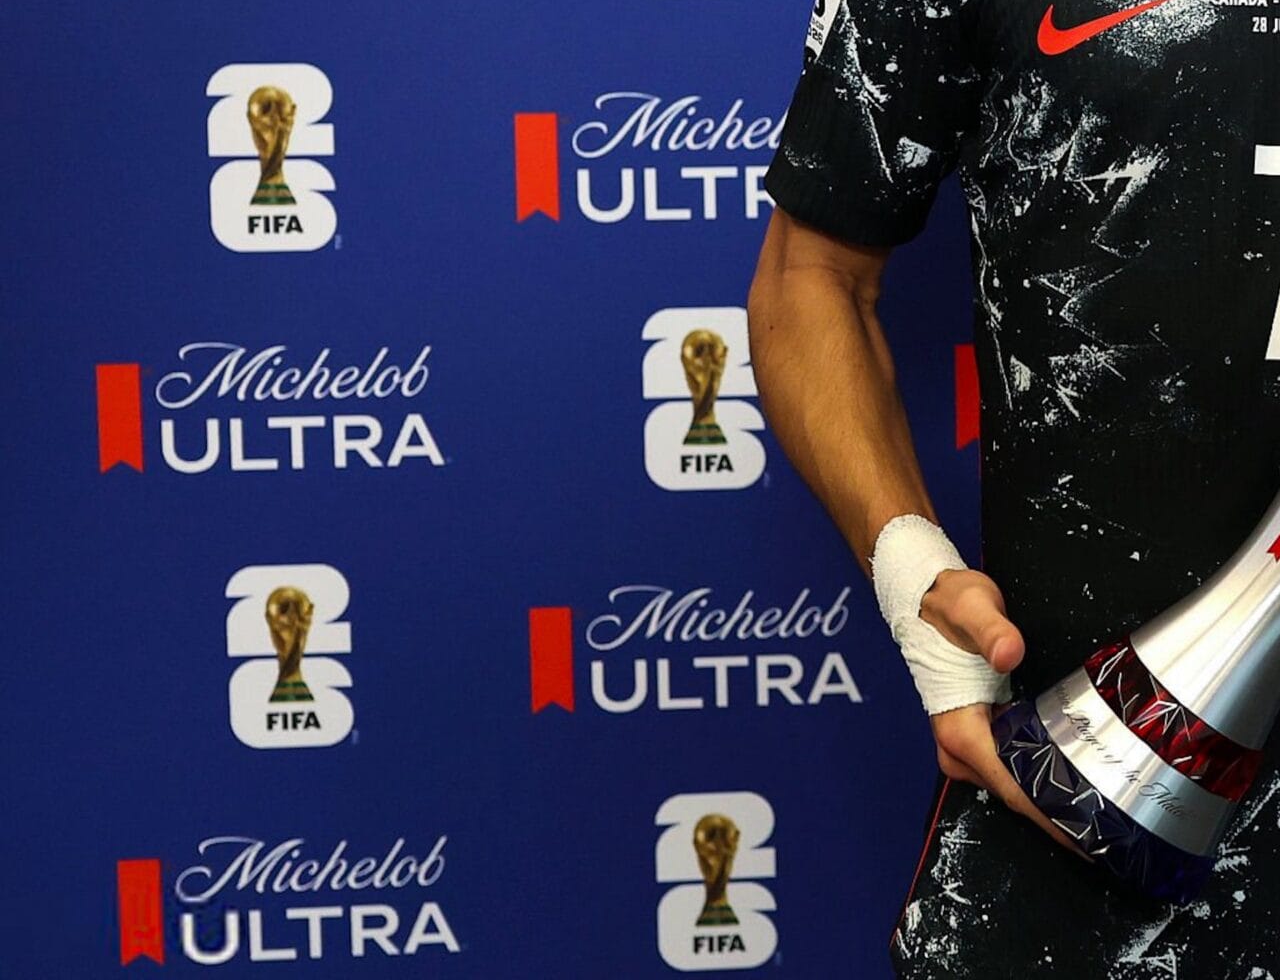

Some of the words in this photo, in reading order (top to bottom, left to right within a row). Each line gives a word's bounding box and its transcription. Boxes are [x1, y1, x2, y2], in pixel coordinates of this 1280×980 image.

[1252, 17, 1267, 33] 28
[577, 166, 776, 223] ULTR
[247, 214, 304, 235] FIFA
[156, 343, 430, 408] Michelob
[161, 414, 444, 473] ULTRA
[680, 453, 734, 474] FIFA
[587, 586, 850, 650] Michelob
[591, 653, 862, 712] ULTRA
[266, 711, 321, 731] FIFA
[176, 837, 446, 902] Michelob
[181, 903, 459, 964] ULTRA
[693, 934, 746, 955] FIFA
